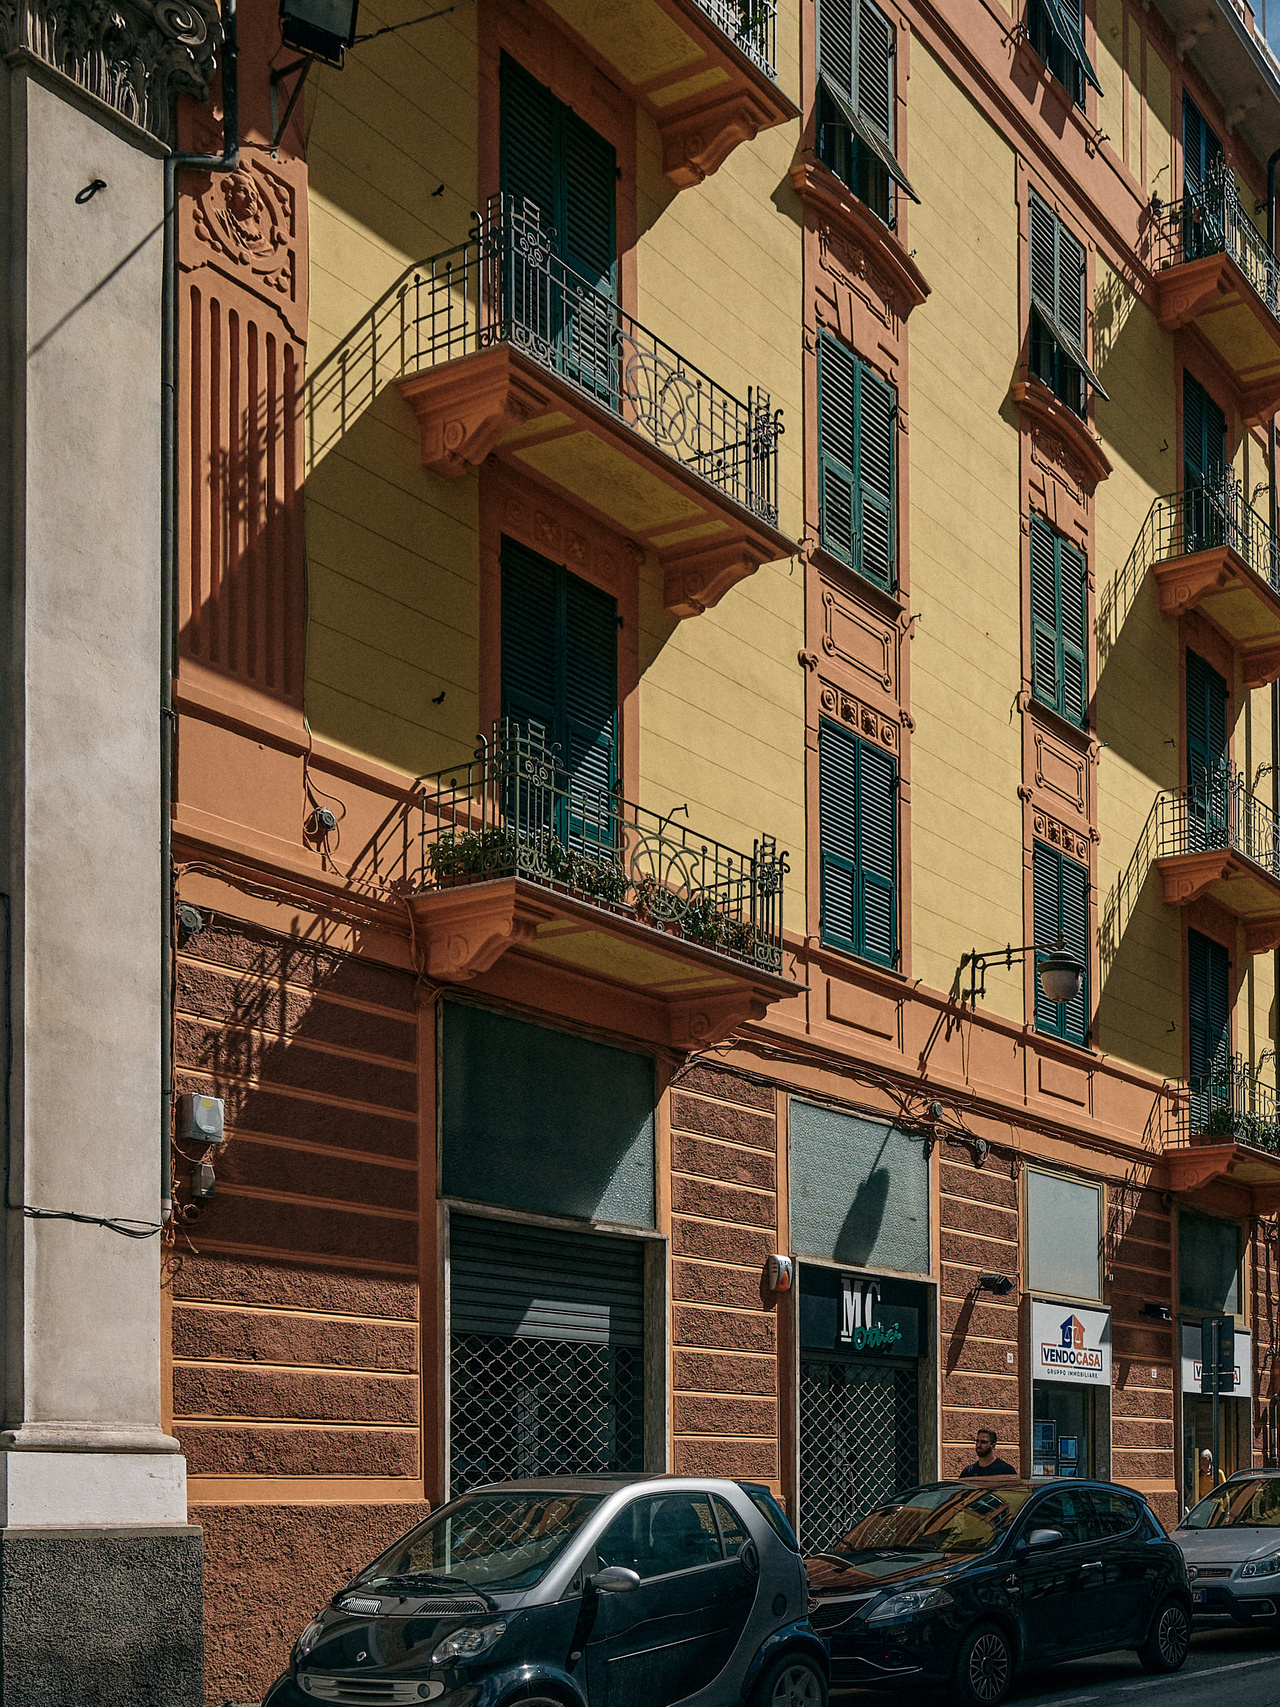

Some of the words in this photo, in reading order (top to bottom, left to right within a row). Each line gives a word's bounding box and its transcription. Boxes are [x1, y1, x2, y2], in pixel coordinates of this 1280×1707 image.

[1043, 1347, 1101, 1367] VENDOCASA
[1047, 1368, 1066, 1376] GRUPPO
[1068, 1370, 1098, 1379] IMMOBILIARE
